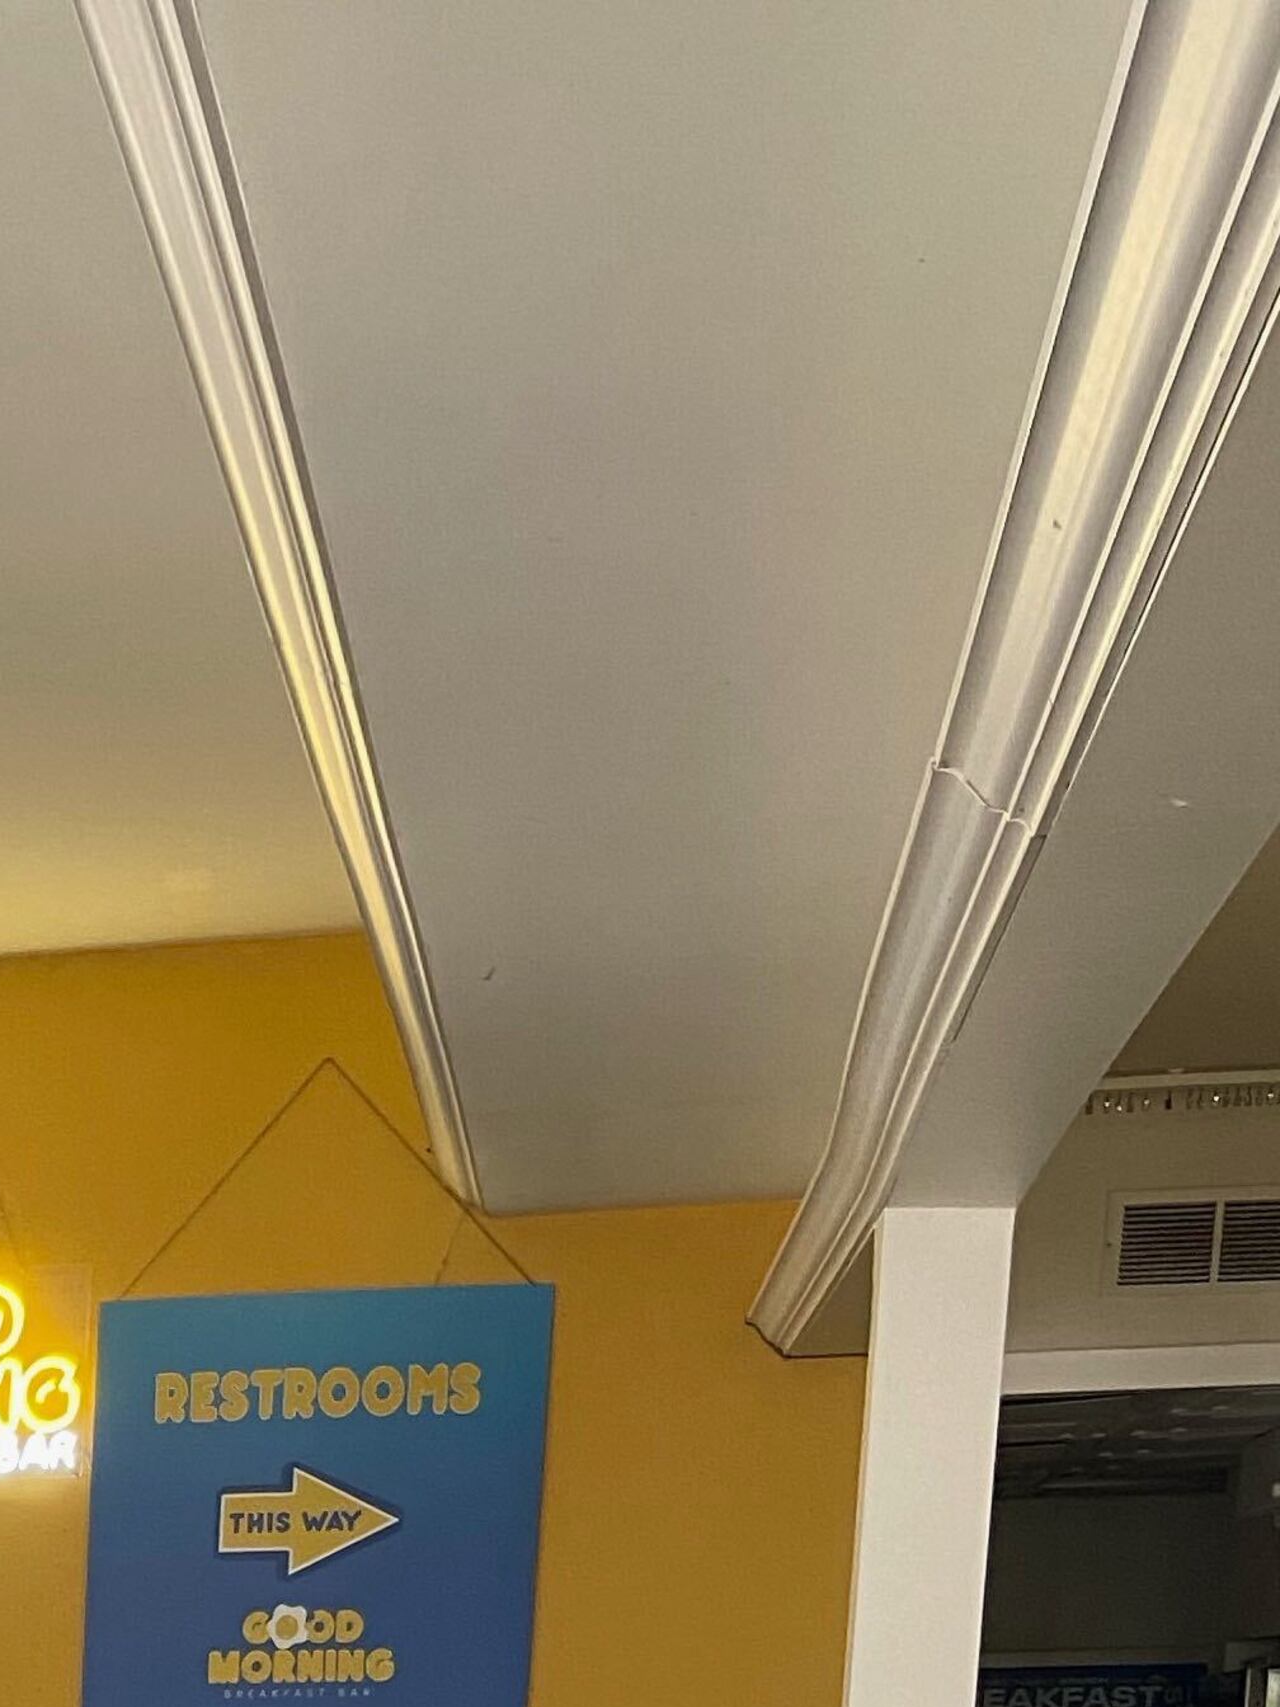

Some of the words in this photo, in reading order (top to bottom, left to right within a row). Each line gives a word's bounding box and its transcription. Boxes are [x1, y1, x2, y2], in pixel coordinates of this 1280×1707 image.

[153, 1362, 482, 1425] RESTROOMS
[229, 1512, 291, 1534] THIS
[300, 1509, 362, 1533] WAY
[242, 1603, 365, 1650] GOOD
[207, 1648, 395, 1685] MORNING
[223, 1687, 327, 1700] BREAKFAST
[337, 1686, 371, 1697] BAR
